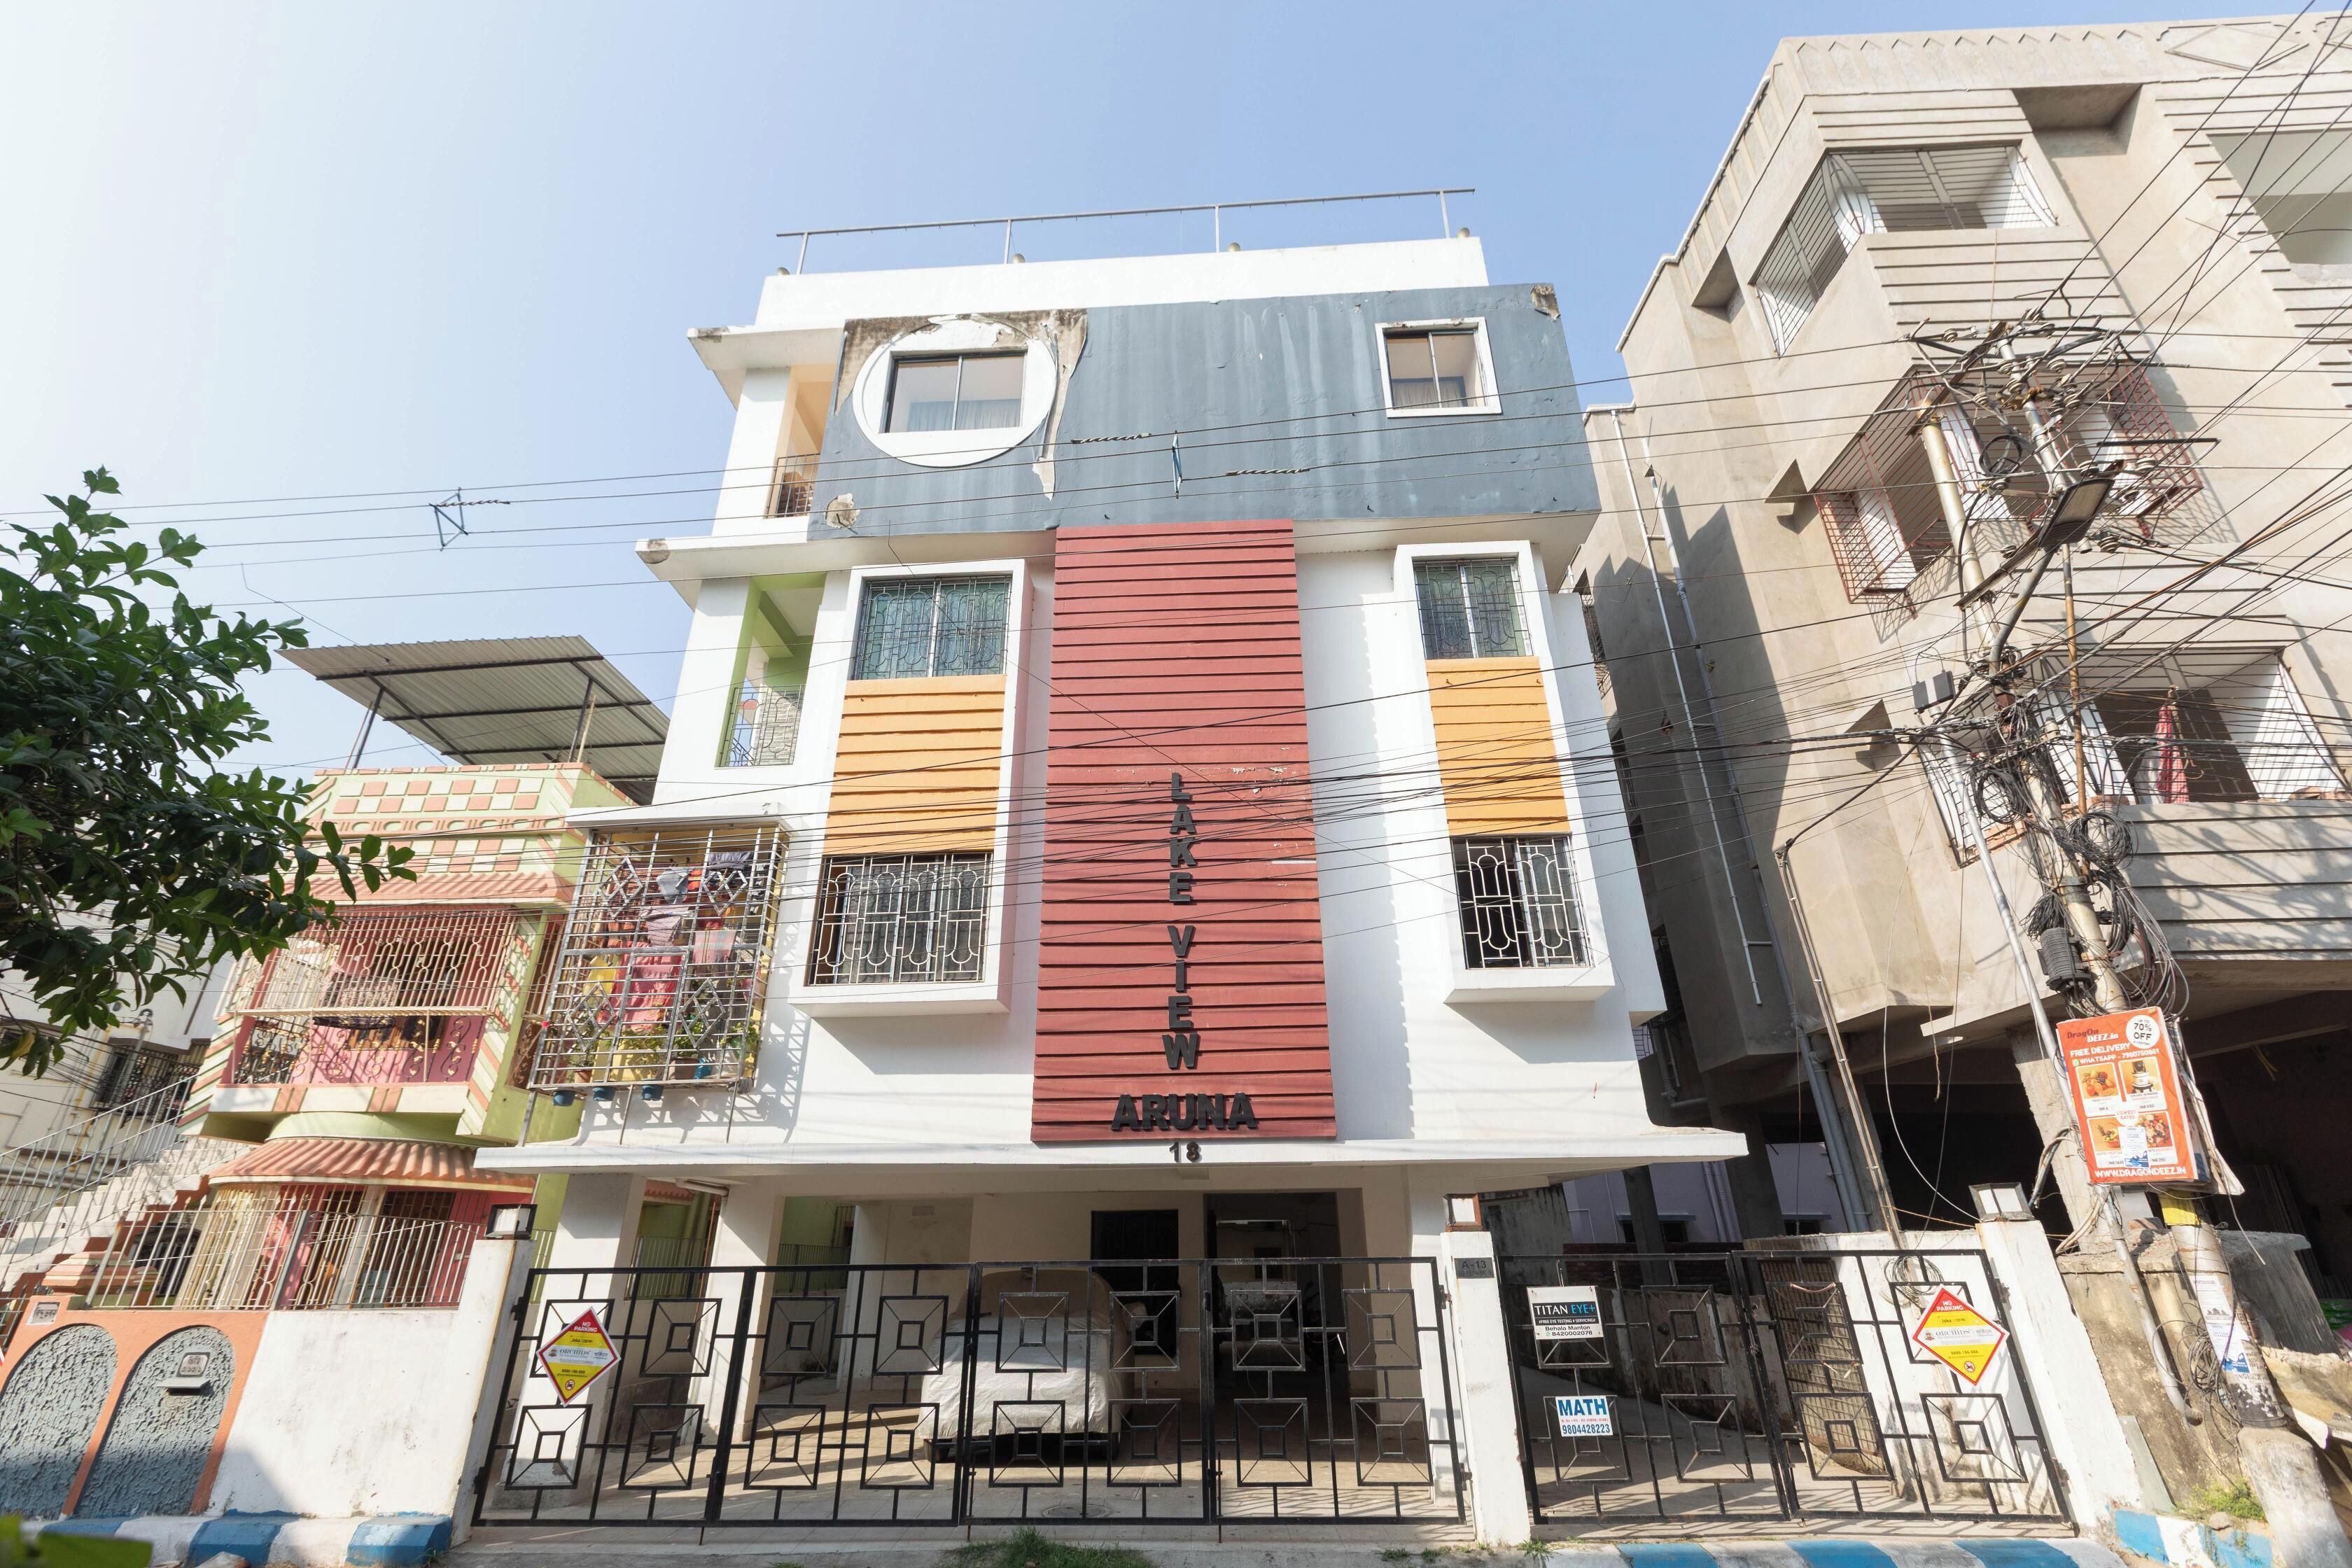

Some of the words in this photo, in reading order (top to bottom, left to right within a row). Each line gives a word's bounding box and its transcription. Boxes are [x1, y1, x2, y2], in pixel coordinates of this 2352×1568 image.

[1169, 772, 1196, 904] LAKE
[1162, 925, 1199, 1070] VIEW
[2067, 1028, 2099, 1039] DragOn
[2134, 1023, 2152, 1032] 70%
[2087, 1032, 2119, 1043] DEEZ.in
[2134, 1032, 2152, 1041] OFF
[2070, 1048, 2090, 1058] FREE
[2090, 1042, 2131, 1055] DELIVERY
[2079, 1054, 2116, 1065] WHATSAPP
[1111, 1093, 1258, 1132] ARUNA
[1170, 1142, 1200, 1163] 18
[2094, 1166, 2187, 1178] WWW.DRAGONDEEZ.IN
[1462, 1260, 1487, 1269] A-13
[1534, 1305, 1568, 1315] TITAN
[1571, 1303, 1595, 1314] EYE+
[1558, 1399, 1607, 1416] MATH
[1562, 1423, 1611, 1434] 9804428223
